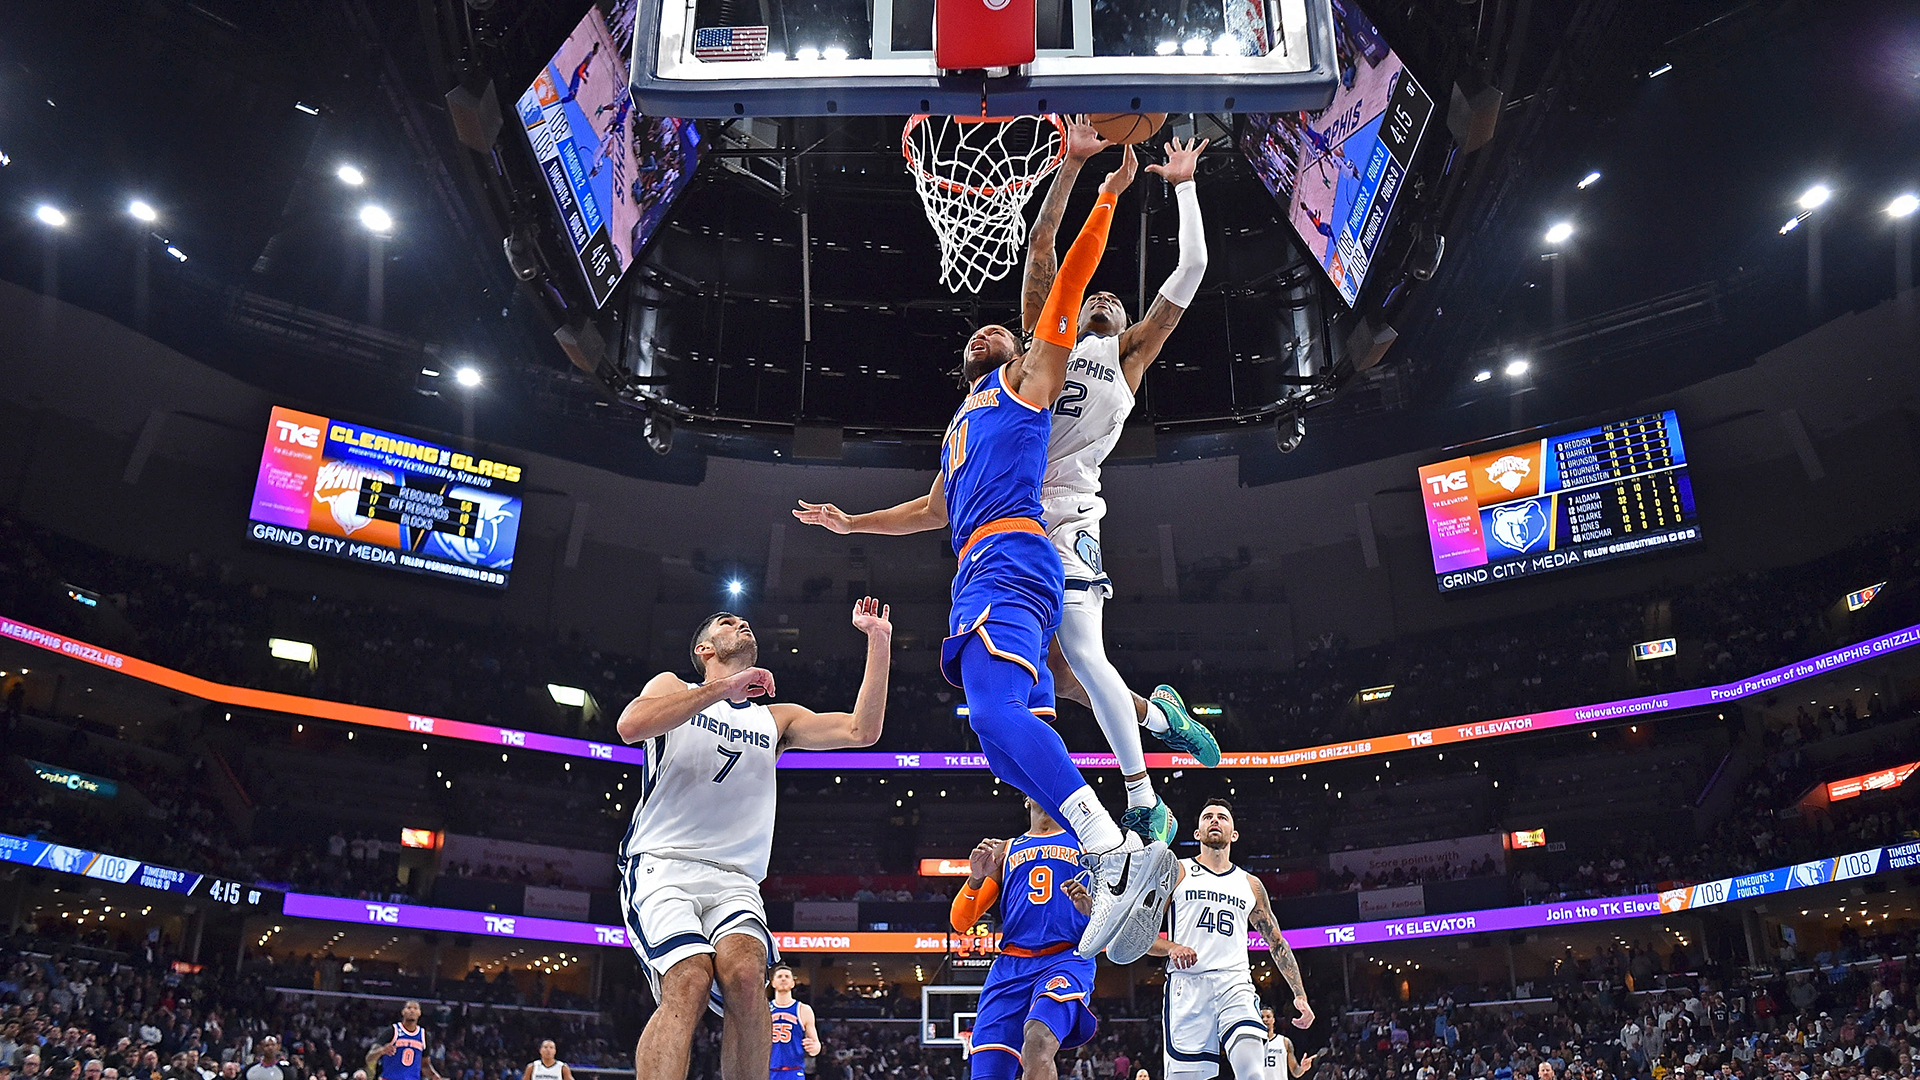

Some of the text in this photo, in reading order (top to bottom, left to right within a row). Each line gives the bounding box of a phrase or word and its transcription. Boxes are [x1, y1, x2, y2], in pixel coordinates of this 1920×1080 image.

[1405, 80, 1415, 96] OT
[548, 107, 569, 141] 108
[1388, 103, 1414, 144] 4:15
[532, 127, 554, 161] 108
[1366, 146, 1384, 182] FOULS: 0
[1380, 165, 1399, 202] FOULS: 0
[1348, 186, 1370, 229] TIMEOUTS: 2
[1361, 205, 1384, 249] TIMEOUTS: 2
[1334, 230, 1354, 260] 108
[590, 242, 611, 277] 4:15
[1349, 249, 1368, 276] 108
[1067, 357, 1116, 382] PHIS
[966, 388, 1001, 413] ORK
[1054, 380, 1088, 418] 2
[276, 420, 320, 448] TKE
[1557, 432, 1614, 451] 0 REDDISH 20
[330, 425, 439, 464] CLEANING
[451, 453, 522, 483] GLASS
[949, 418, 969, 481] 11
[1566, 447, 1592, 458] BARRETT
[1560, 461, 1566, 469] 11
[1568, 455, 1598, 468] BRUNSON
[1561, 460, 1619, 479] 13 FOURNIER 14
[1426, 470, 1468, 495] TKE
[1571, 471, 1610, 486] HARTENSTEIN
[1613, 469, 1621, 477] 14
[399, 487, 444, 507] REBOUNDS
[1441, 496, 1468, 507] ELEVATOR
[1568, 497, 1573, 505] 7
[1574, 492, 1601, 504] ALDAMA
[1633, 483, 1641, 491] 10
[389, 497, 405, 511] OFF
[405, 502, 450, 521] REBOUNDS
[1568, 496, 1627, 515] 12 MORANT 32
[400, 513, 433, 530] BLOCKS
[1571, 515, 1630, 533] 21 JONES 12
[1578, 511, 1602, 523] CLARKE
[1581, 524, 1632, 541] KONCHAR 12
[253, 524, 397, 565] GRIND CITY MEDIA
[1583, 535, 1669, 559] FOLLOW @GRINDCITYMEDIA
[400, 555, 424, 570] FOLLOW
[1443, 551, 1579, 588] GRIND CITY MEDIA
[1, 622, 123, 668] MEMPHIS GRIZZLIES
[1711, 629, 1920, 700] Proud Partner of the MEMPHIS GRIZZLI
[1574, 698, 1669, 721] tkelevator.com/us
[407, 715, 434, 732] TKE
[690, 713, 770, 749] MEMPHIS
[1457, 718, 1533, 738] TK ELEVATOR
[500, 729, 526, 746] TKE
[1407, 731, 1433, 747] TKE
[588, 743, 613, 759] TKE
[895, 755, 920, 767] TKE
[944, 756, 989, 765] TK ELEV
[1239, 756, 1250, 765] of
[1251, 755, 1268, 765] the
[1269, 751, 1317, 765] MEMPHIS
[1319, 742, 1372, 759] GRIZZLIES
[712, 744, 744, 784] 7
[21, 841, 29, 851] 2
[1887, 843, 1920, 858] TIMEOUT
[1009, 845, 1079, 872] NEW YORK
[1844, 853, 1871, 876] 108
[1889, 856, 1916, 869] FOULS:
[100, 858, 127, 880] 108
[143, 865, 185, 883] TIMEOUTS: 2
[140, 875, 163, 889] FOULS:
[1028, 865, 1053, 905] 9
[1735, 872, 1775, 888] TIMEOUTS: 2
[209, 880, 241, 904] 4:15
[1185, 889, 1246, 910] MEMPHIS
[1701, 883, 1724, 903] 108
[1737, 886, 1765, 898] FOULS: 0
[365, 904, 399, 923] TKE
[1546, 901, 1660, 921] Join the TK Eleva
[484, 916, 515, 934] TKE
[1196, 906, 1234, 937] 46
[1386, 917, 1476, 937] TK ELEVATOR
[595, 927, 624, 944] TKE
[783, 936, 850, 948] ELEVATOR
[914, 937, 939, 949] Join
[1325, 927, 1355, 943] TKE
[772, 1023, 793, 1043] 55
[401, 1048, 414, 1066] 0
[1264, 1056, 1276, 1067] 15
